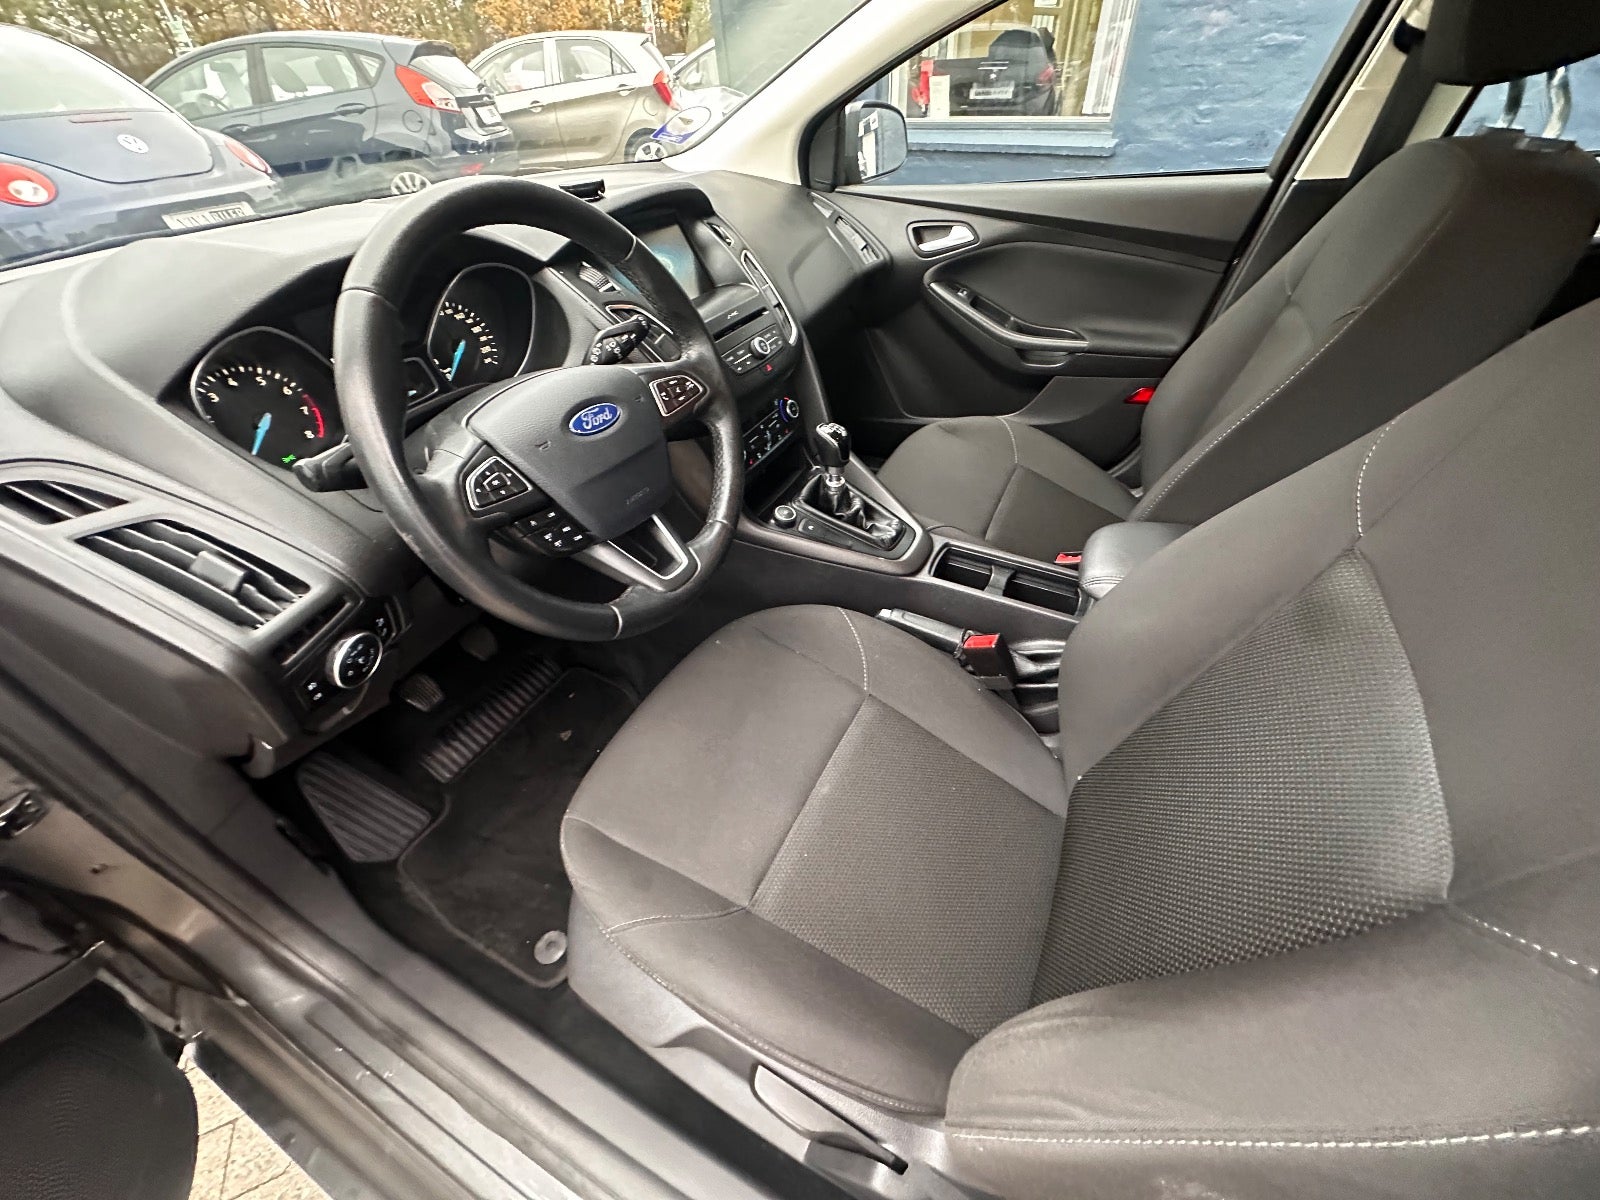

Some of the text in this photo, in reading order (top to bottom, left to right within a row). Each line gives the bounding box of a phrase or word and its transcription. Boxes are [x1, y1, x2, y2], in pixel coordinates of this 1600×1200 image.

[255, 376, 267, 386] 5
[282, 386, 293, 396] 6
[207, 392, 219, 402] 3
[299, 405, 309, 415] 7
[581, 407, 613, 430] Ford
